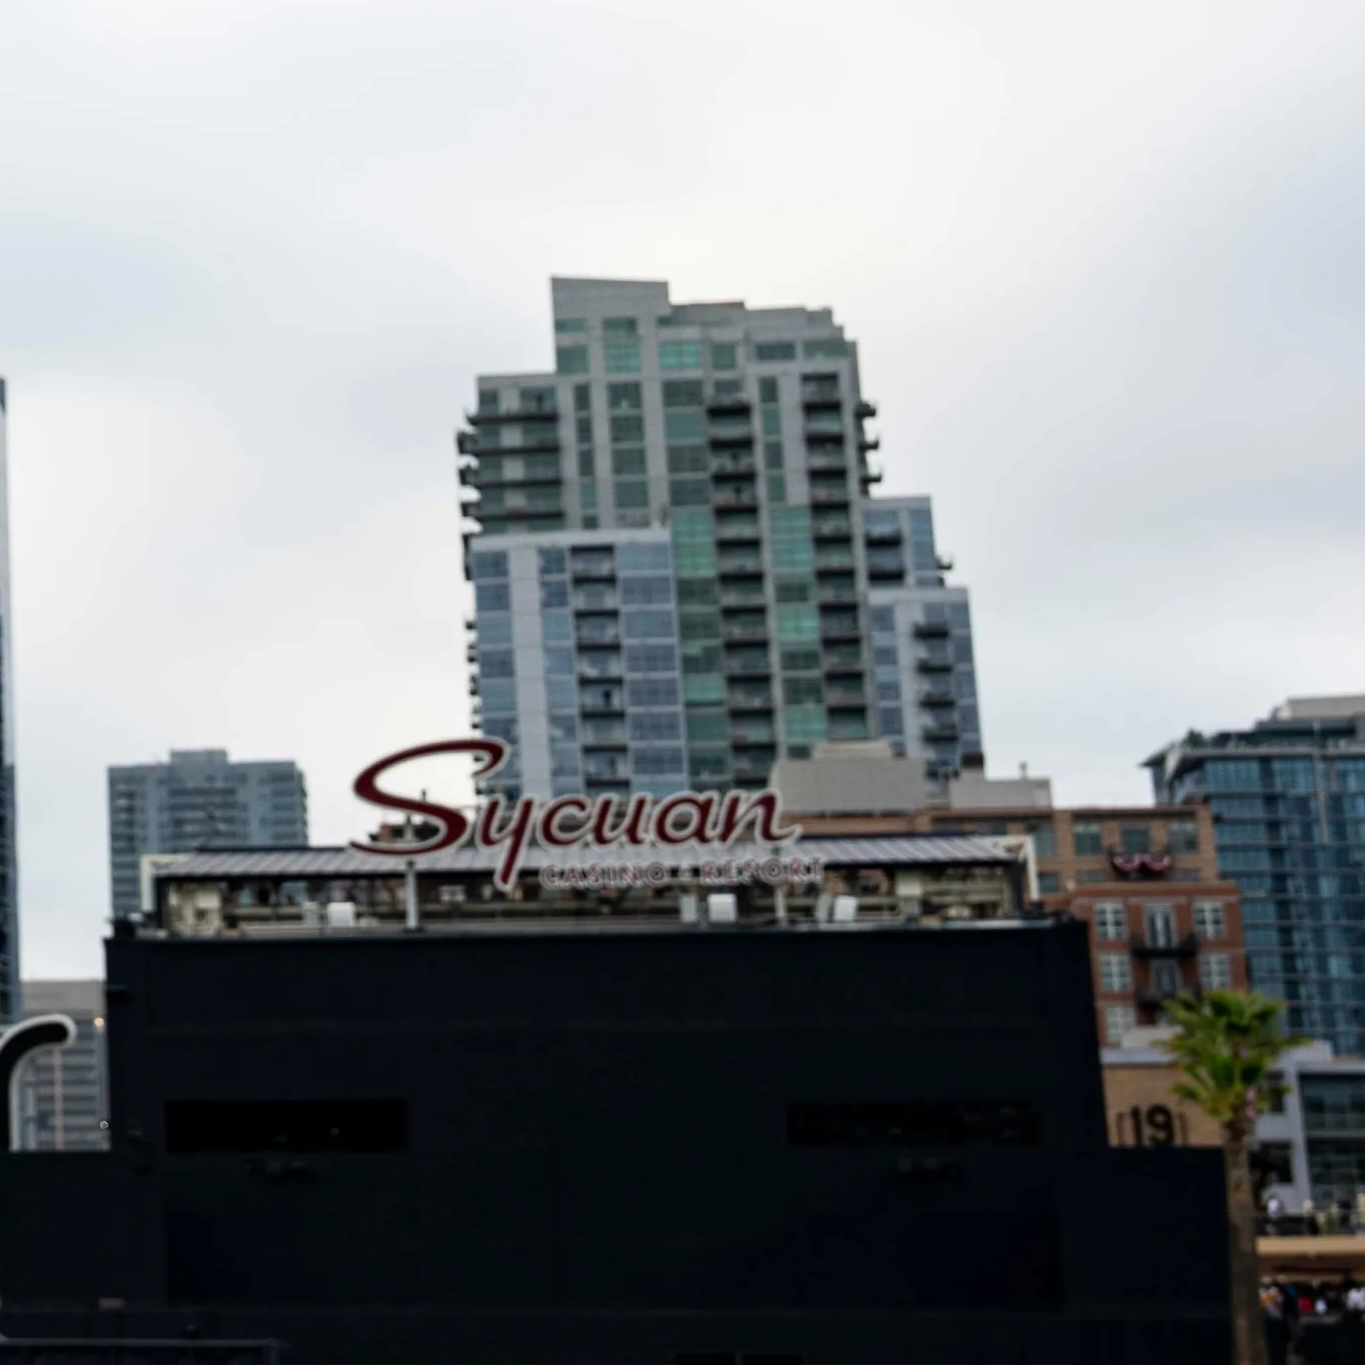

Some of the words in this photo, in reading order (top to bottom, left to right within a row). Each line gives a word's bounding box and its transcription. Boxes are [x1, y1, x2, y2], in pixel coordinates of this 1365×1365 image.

[349, 738, 803, 890] Sycuan
[540, 859, 669, 889] CASINO
[699, 854, 826, 885] RESORT
